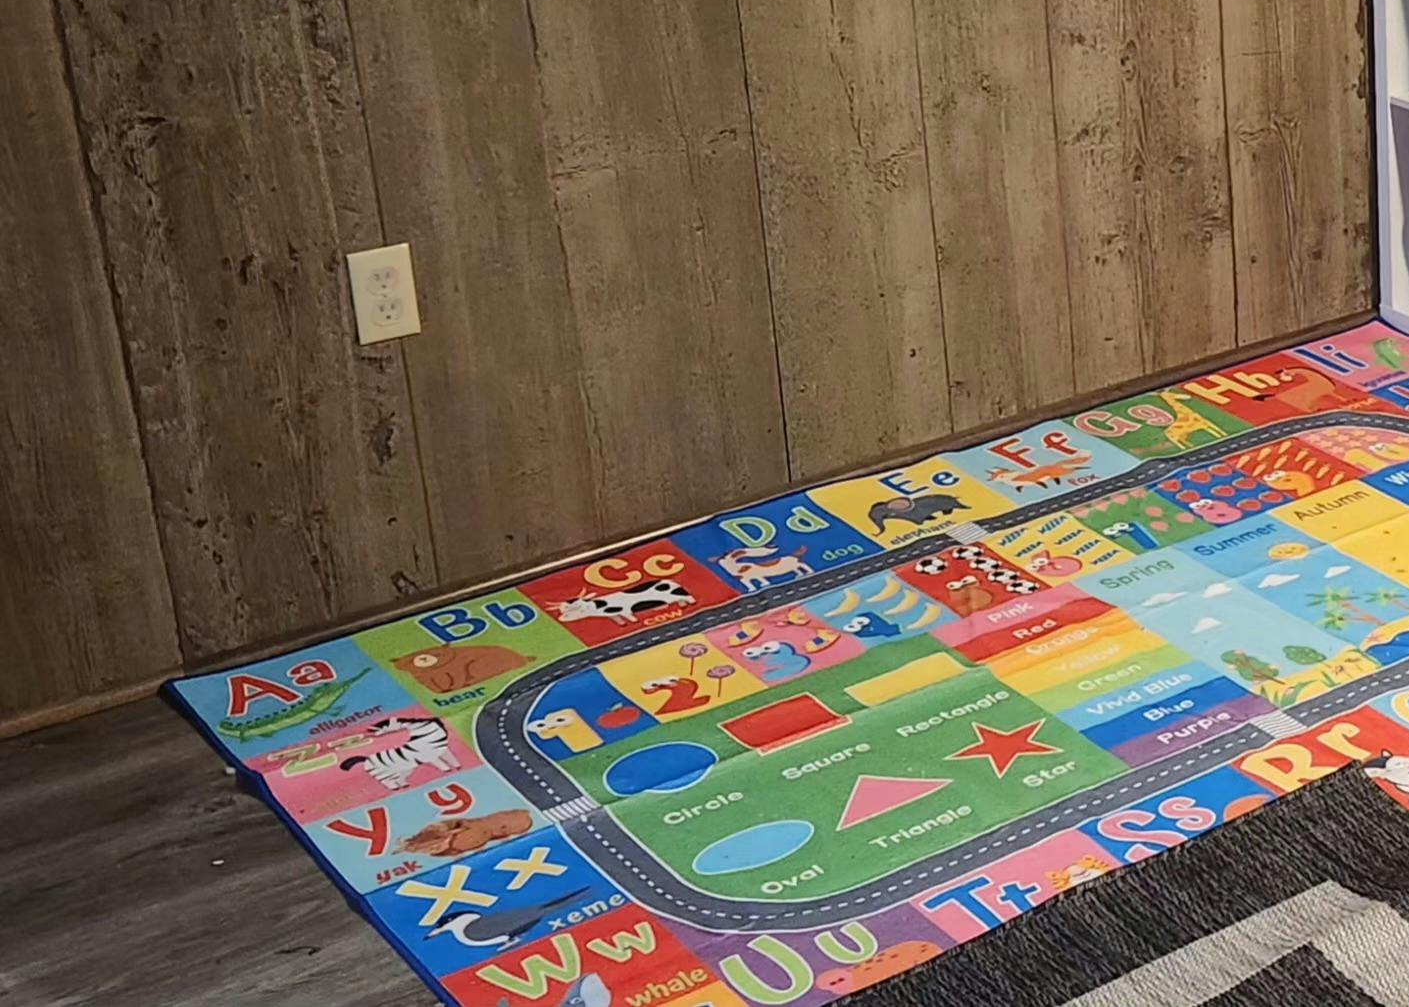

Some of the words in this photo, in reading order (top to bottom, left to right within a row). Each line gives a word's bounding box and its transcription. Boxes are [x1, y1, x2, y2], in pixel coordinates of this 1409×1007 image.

[1067, 471, 1101, 487] fox
[1293, 489, 1370, 523] Autumn
[890, 519, 957, 547] elephant
[1192, 521, 1280, 560] Summer
[822, 542, 864, 564] dog
[1100, 556, 1177, 593] Spring
[643, 608, 685, 628] cow
[987, 600, 1034, 624] Pink
[1012, 618, 1058, 641] Red
[1024, 625, 1099, 656] Orange
[1057, 643, 1122, 672] Yellow
[1076, 663, 1143, 692] Green
[433, 684, 486, 709] bear
[1086, 691, 1143, 717] Vivid
[1143, 671, 1194, 695] Blue
[896, 688, 1011, 739] Rectangle
[1143, 698, 1195, 723] Blue
[1156, 710, 1233, 746] Purple
[781, 740, 872, 782] Square
[1022, 759, 1078, 789] Star
[662, 790, 745, 827] Circle
[869, 802, 974, 851] Triangle
[376, 859, 424, 886] yak
[760, 864, 825, 895] Oval
[547, 893, 626, 932] xeme
[624, 967, 709, 1007] whale
